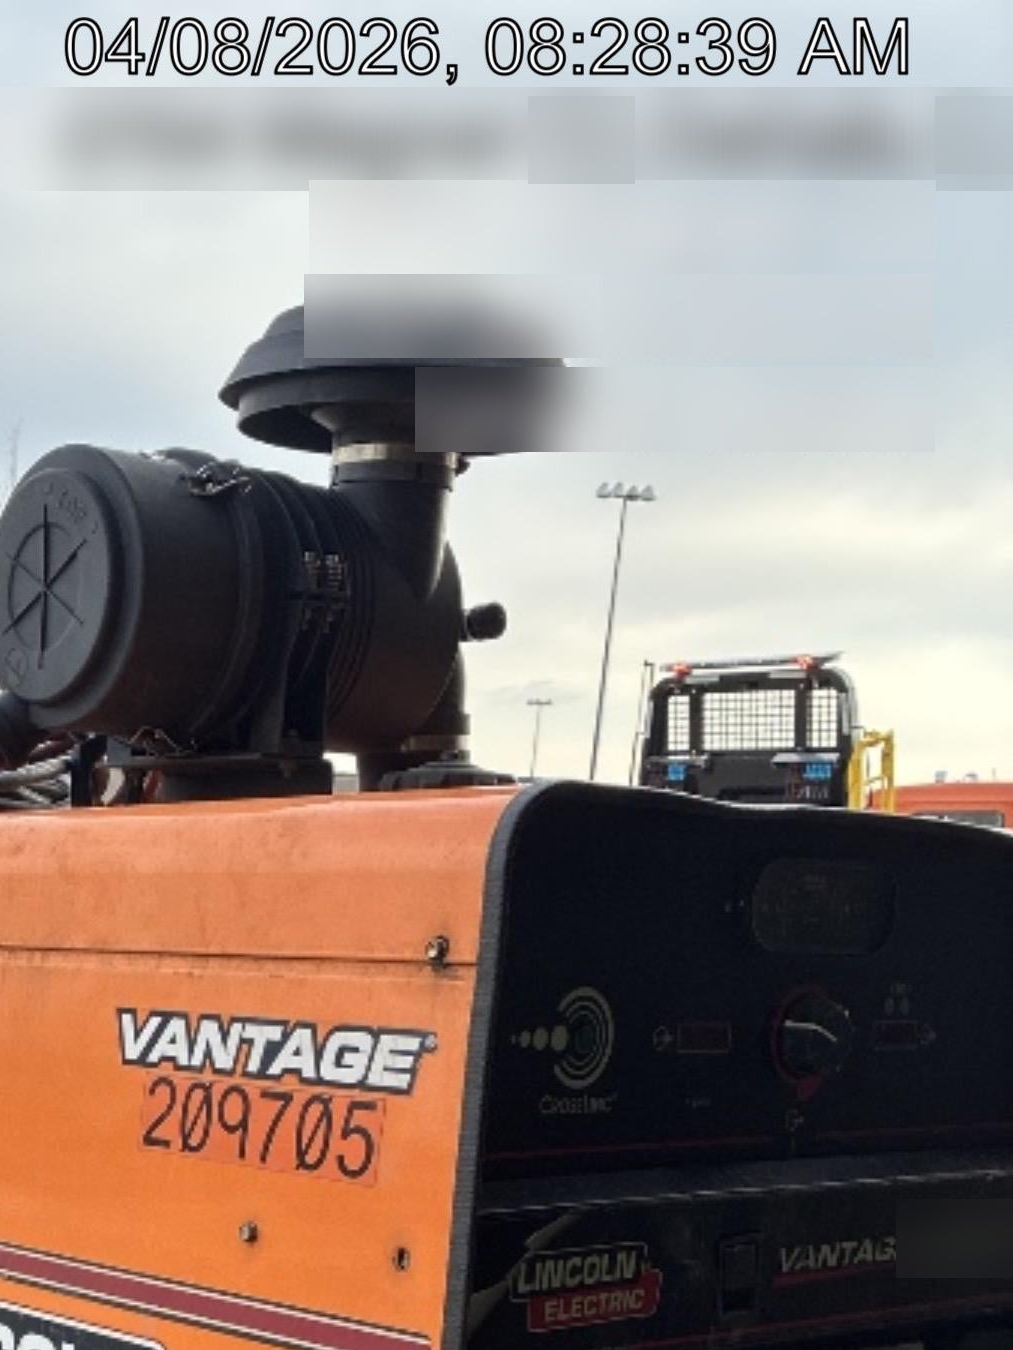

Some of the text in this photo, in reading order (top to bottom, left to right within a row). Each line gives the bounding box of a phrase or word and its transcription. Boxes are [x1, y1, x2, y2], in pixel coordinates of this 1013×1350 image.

[142, 1075, 378, 1179] 209705
[517, 1249, 638, 1293] LINCOLN
[779, 1237, 897, 1273] VANTAG
[544, 1288, 645, 1322] ELECTRIC
